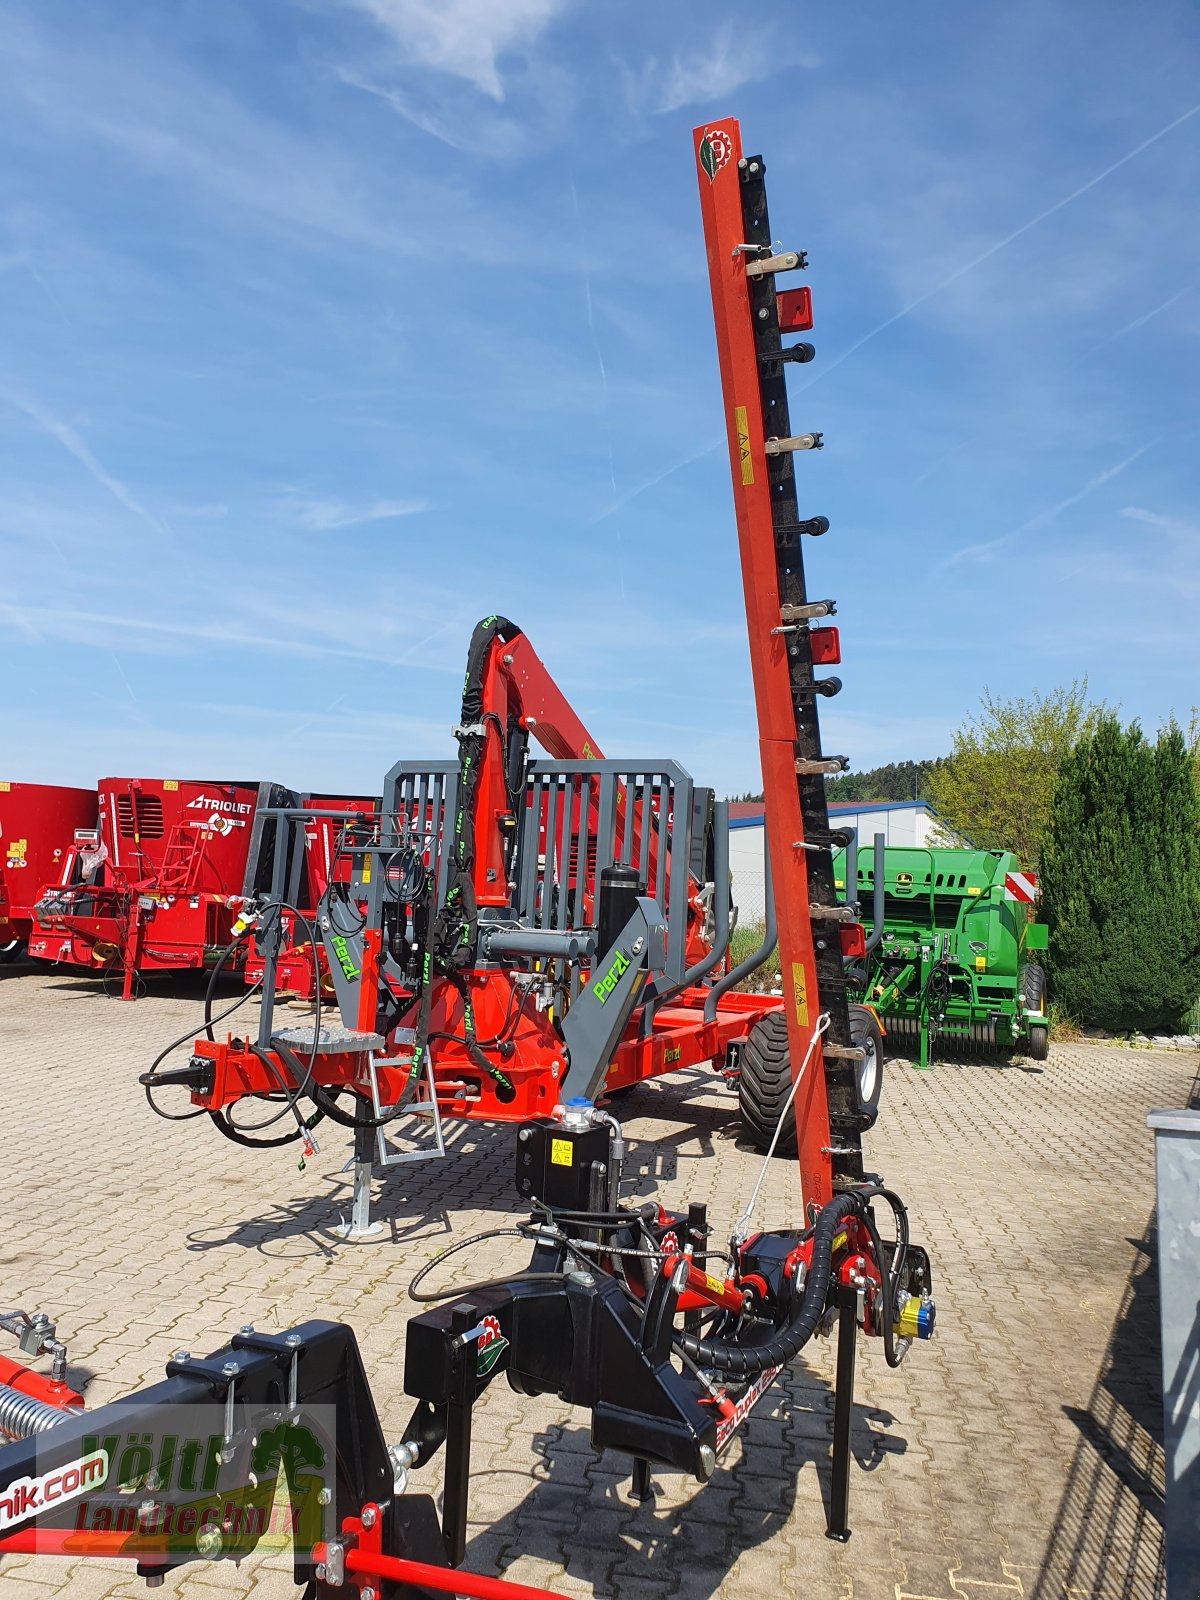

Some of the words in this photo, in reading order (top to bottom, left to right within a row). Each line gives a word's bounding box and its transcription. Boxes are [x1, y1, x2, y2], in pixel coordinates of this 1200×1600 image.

[204, 799, 252, 815] TRIOLIET
[330, 934, 361, 981] Perzl
[424, 952, 435, 985] Perzl
[593, 950, 631, 1004] Perzl
[410, 1046, 423, 1078] Perzl
[664, 1044, 681, 1064] Perzl
